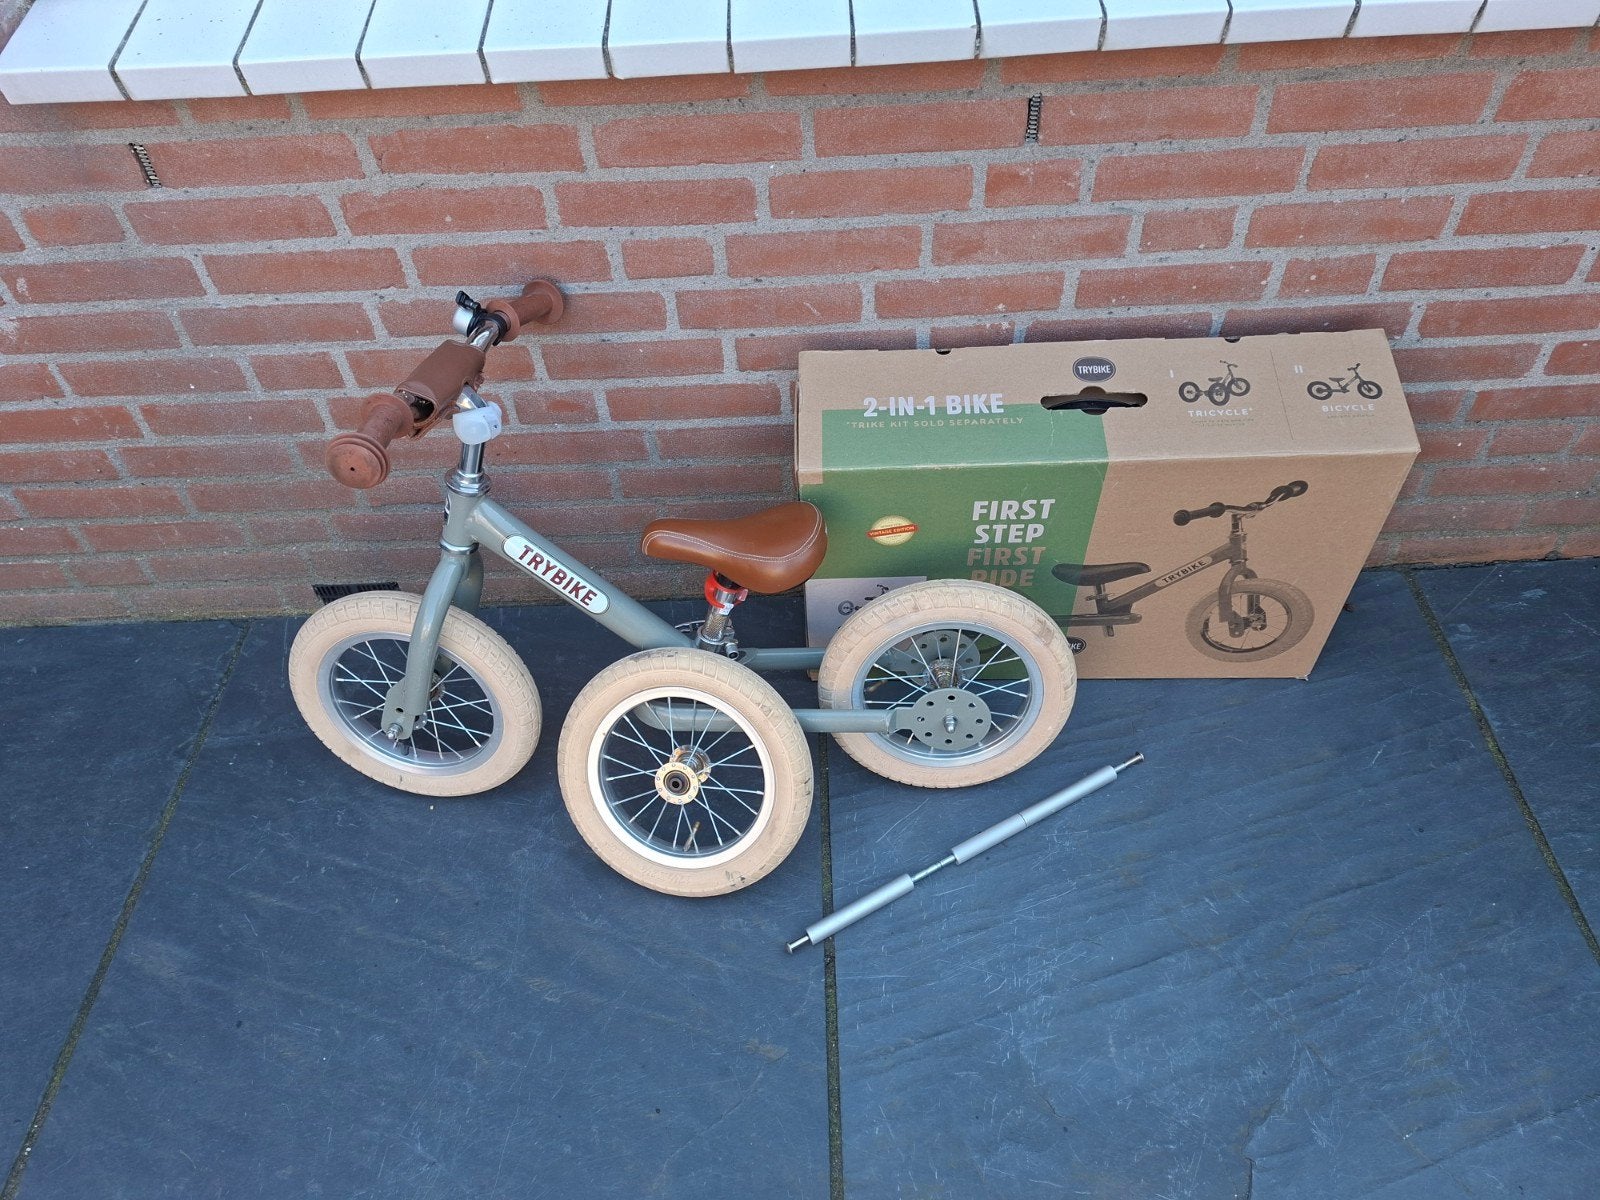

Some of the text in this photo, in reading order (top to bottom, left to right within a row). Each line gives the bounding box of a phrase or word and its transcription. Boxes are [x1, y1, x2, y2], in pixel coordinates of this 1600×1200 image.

[1077, 365, 1111, 374] TRYBIKE
[863, 393, 1005, 417] 2-IN-1 BIKE
[1321, 403, 1375, 413] BICYCLE
[890, 420, 909, 428] KIT
[913, 419, 945, 427] SOLD
[949, 417, 1024, 426] SEPARATELY
[972, 498, 1056, 521] FIRST
[869, 529, 893, 537] VINTAGE
[893, 525, 915, 534] EDITION
[974, 523, 1045, 544] STEP
[966, 546, 1047, 566] FIRST
[518, 544, 598, 606] TRYBIKE
[1162, 560, 1207, 583] TRYBIKE
